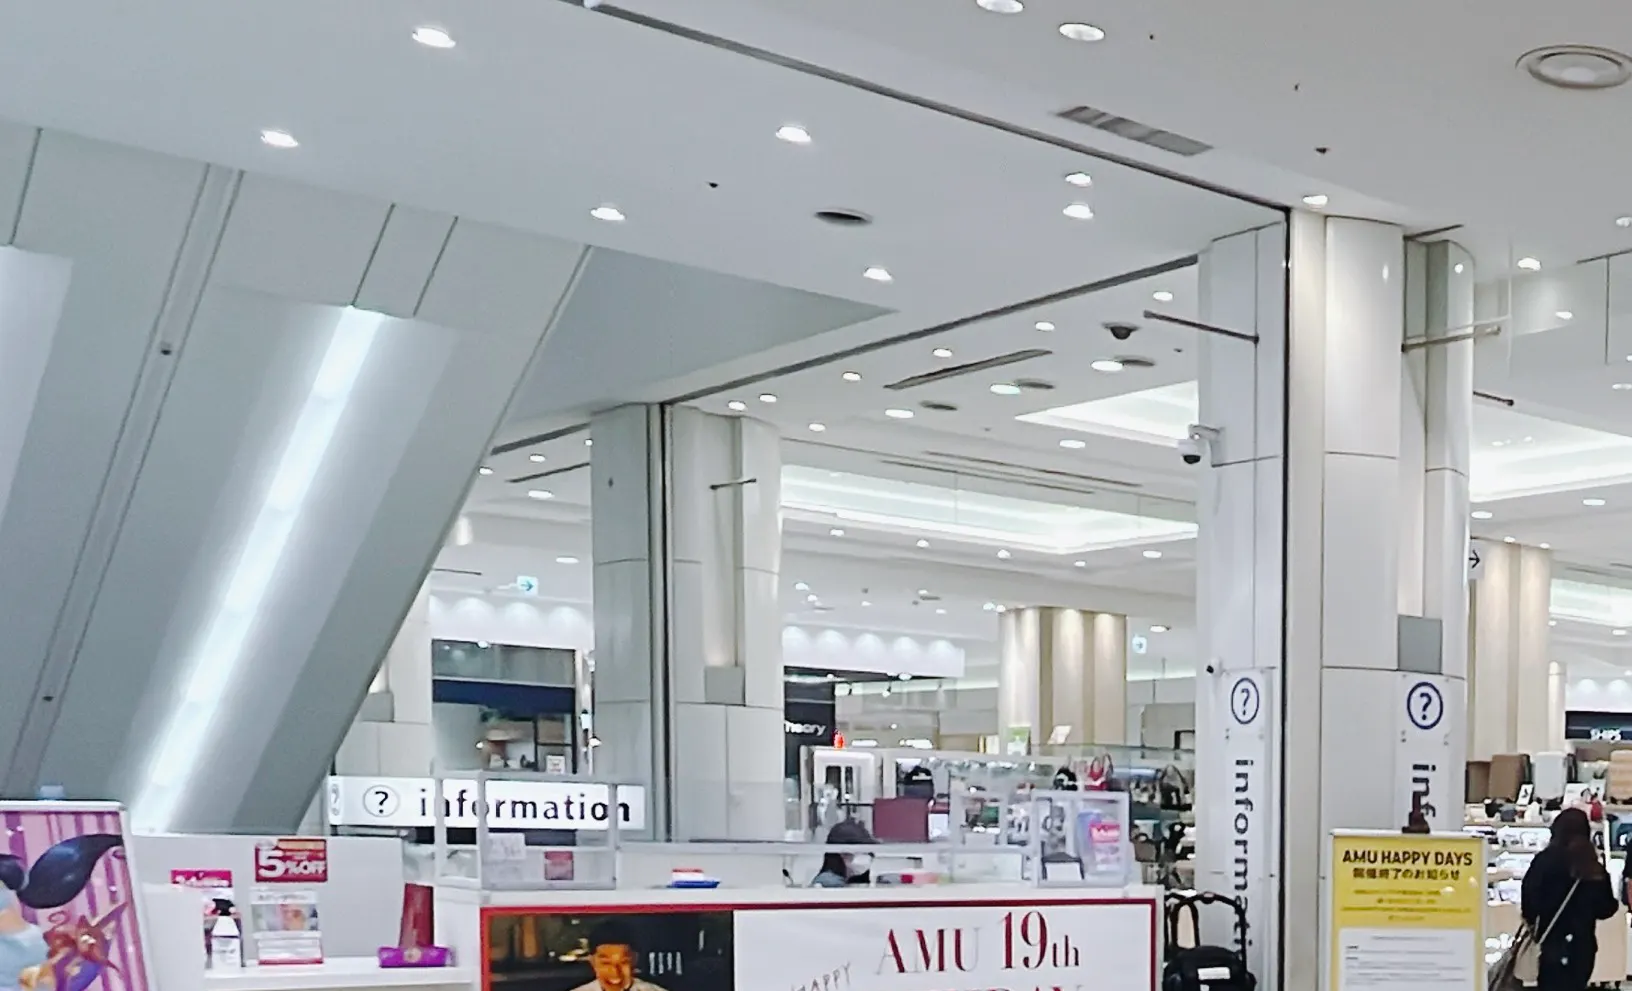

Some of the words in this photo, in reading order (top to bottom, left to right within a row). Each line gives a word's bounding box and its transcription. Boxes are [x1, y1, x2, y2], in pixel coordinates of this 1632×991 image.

[418, 788, 631, 822] information
[1342, 850, 1378, 864] AMU
[1381, 850, 1430, 865] HAPPY
[1434, 851, 1473, 866] DAYS
[876, 927, 981, 975] AMU
[997, 910, 1080, 969] 19th
